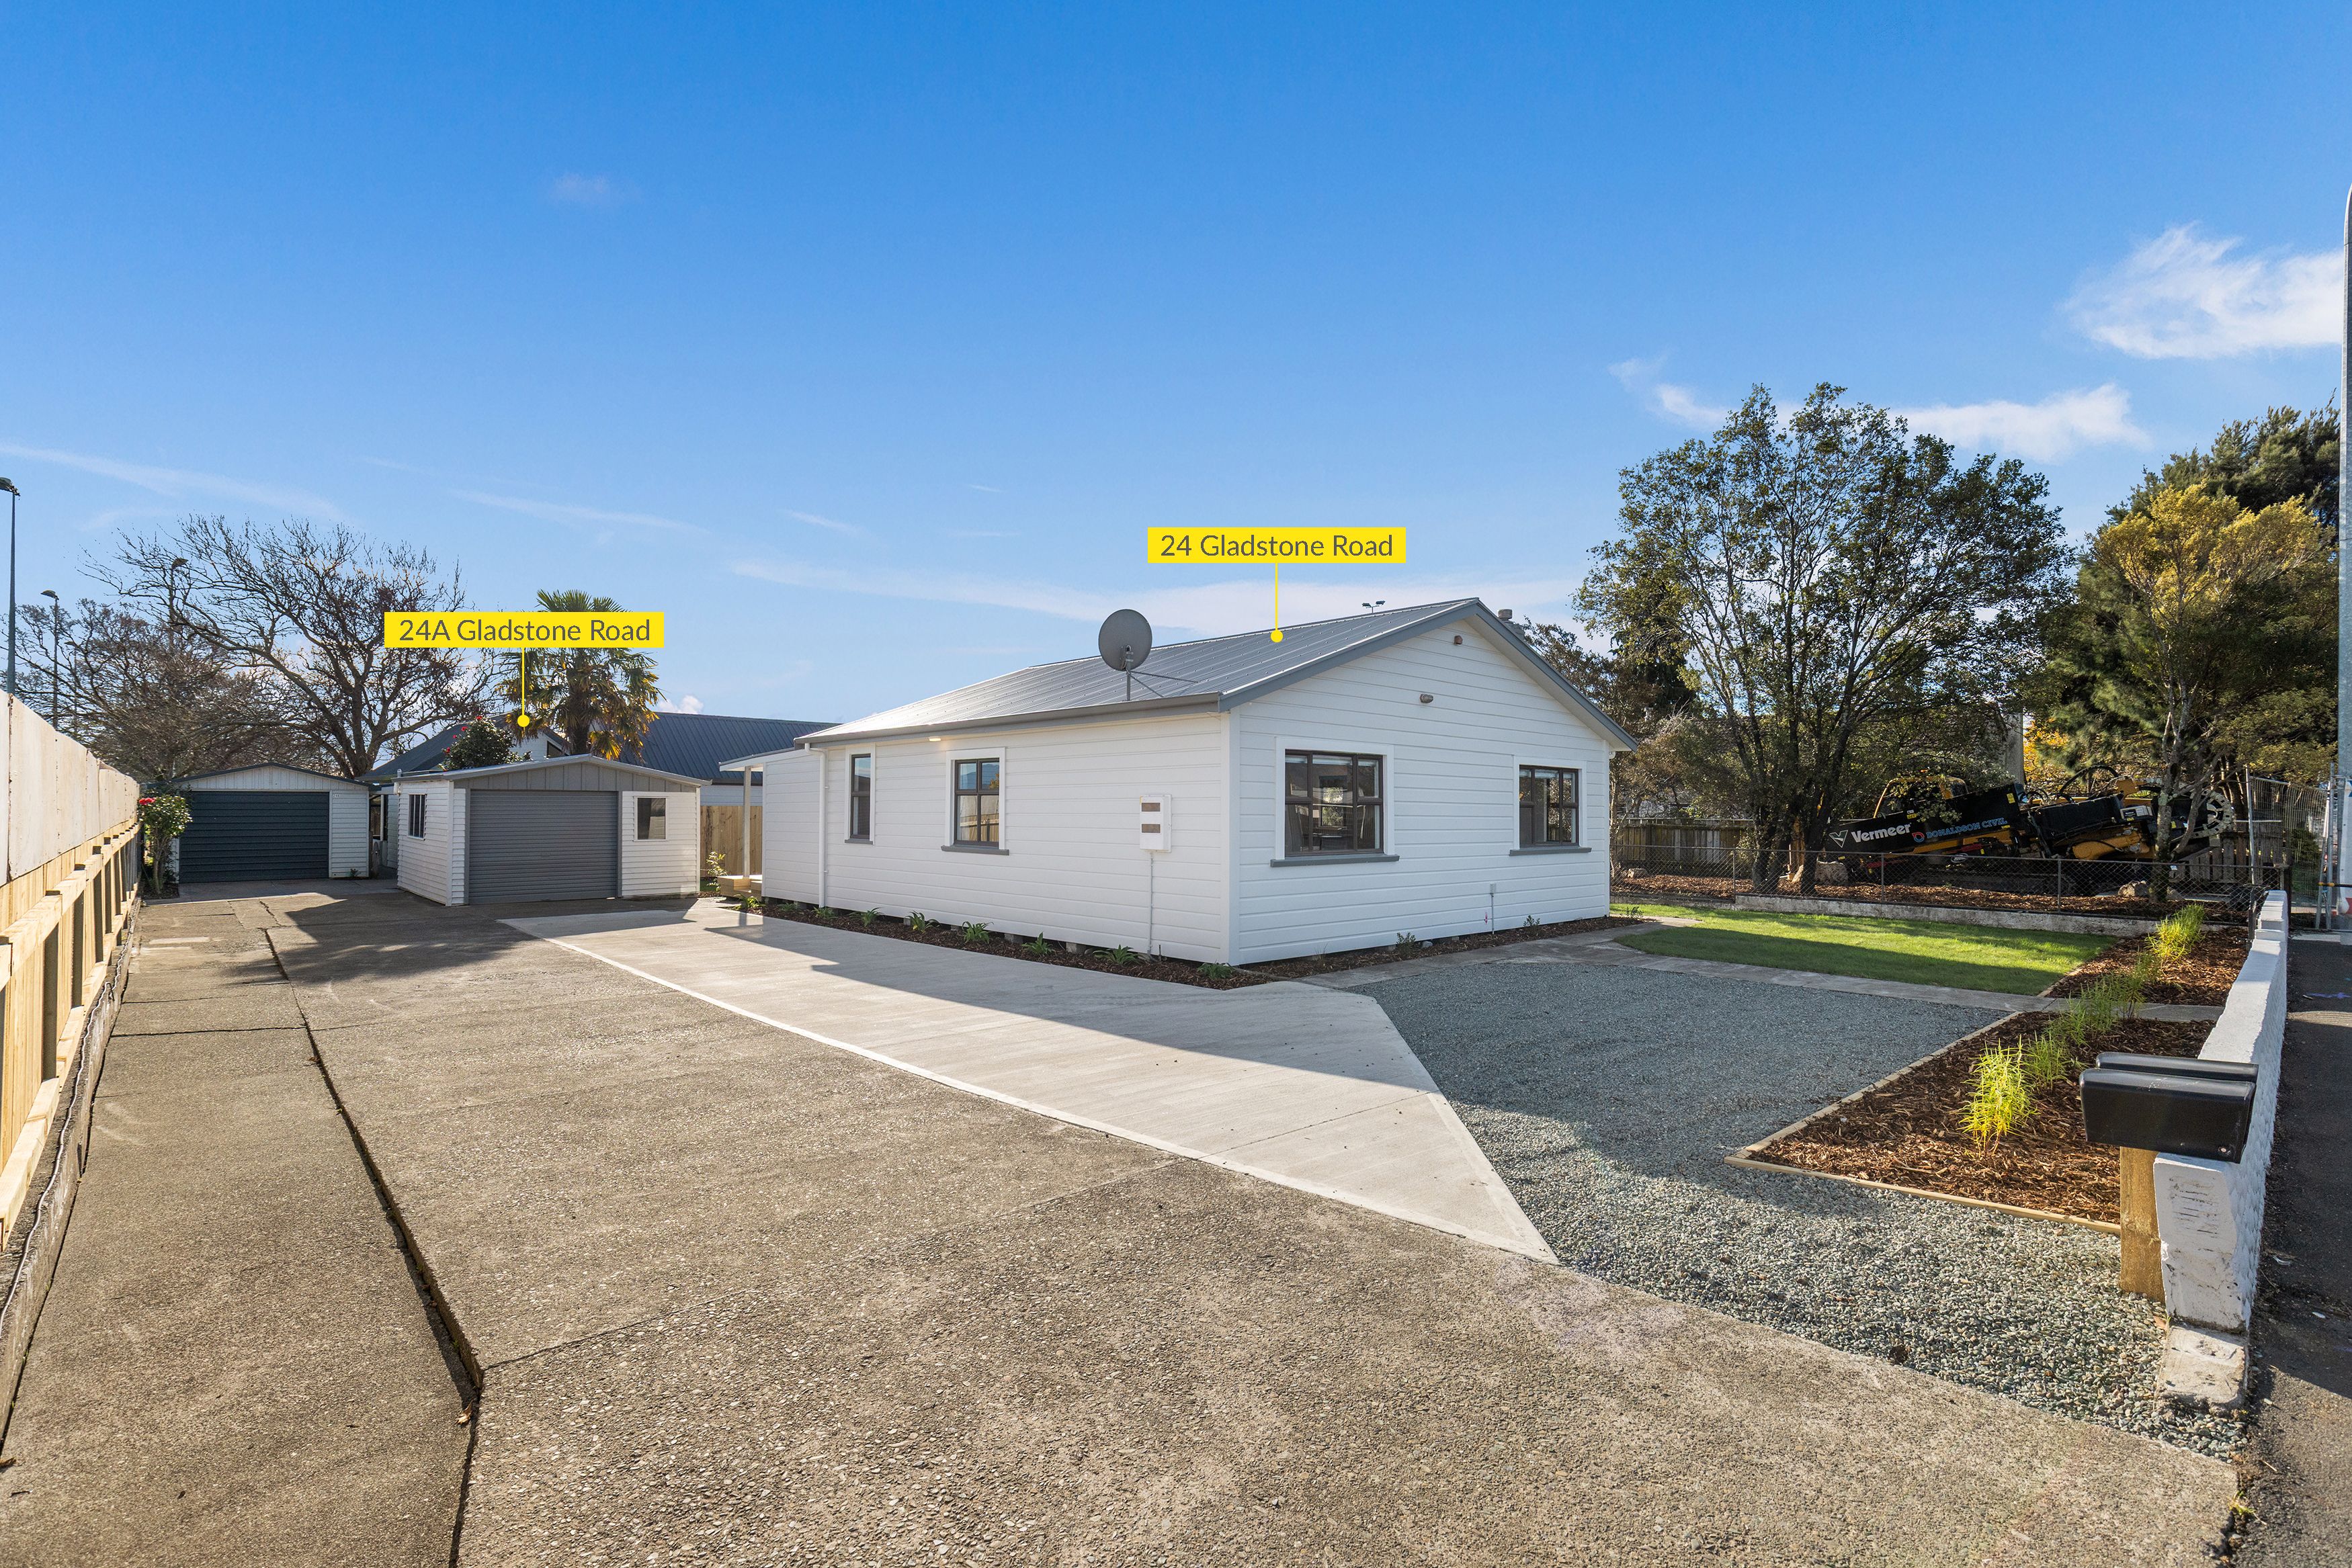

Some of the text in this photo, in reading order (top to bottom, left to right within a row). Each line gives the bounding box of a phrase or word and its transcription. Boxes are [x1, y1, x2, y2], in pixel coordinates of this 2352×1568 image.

[1851, 824, 1911, 842] Vermeer
[1926, 817, 2008, 839] DONALDSON CIVIL
